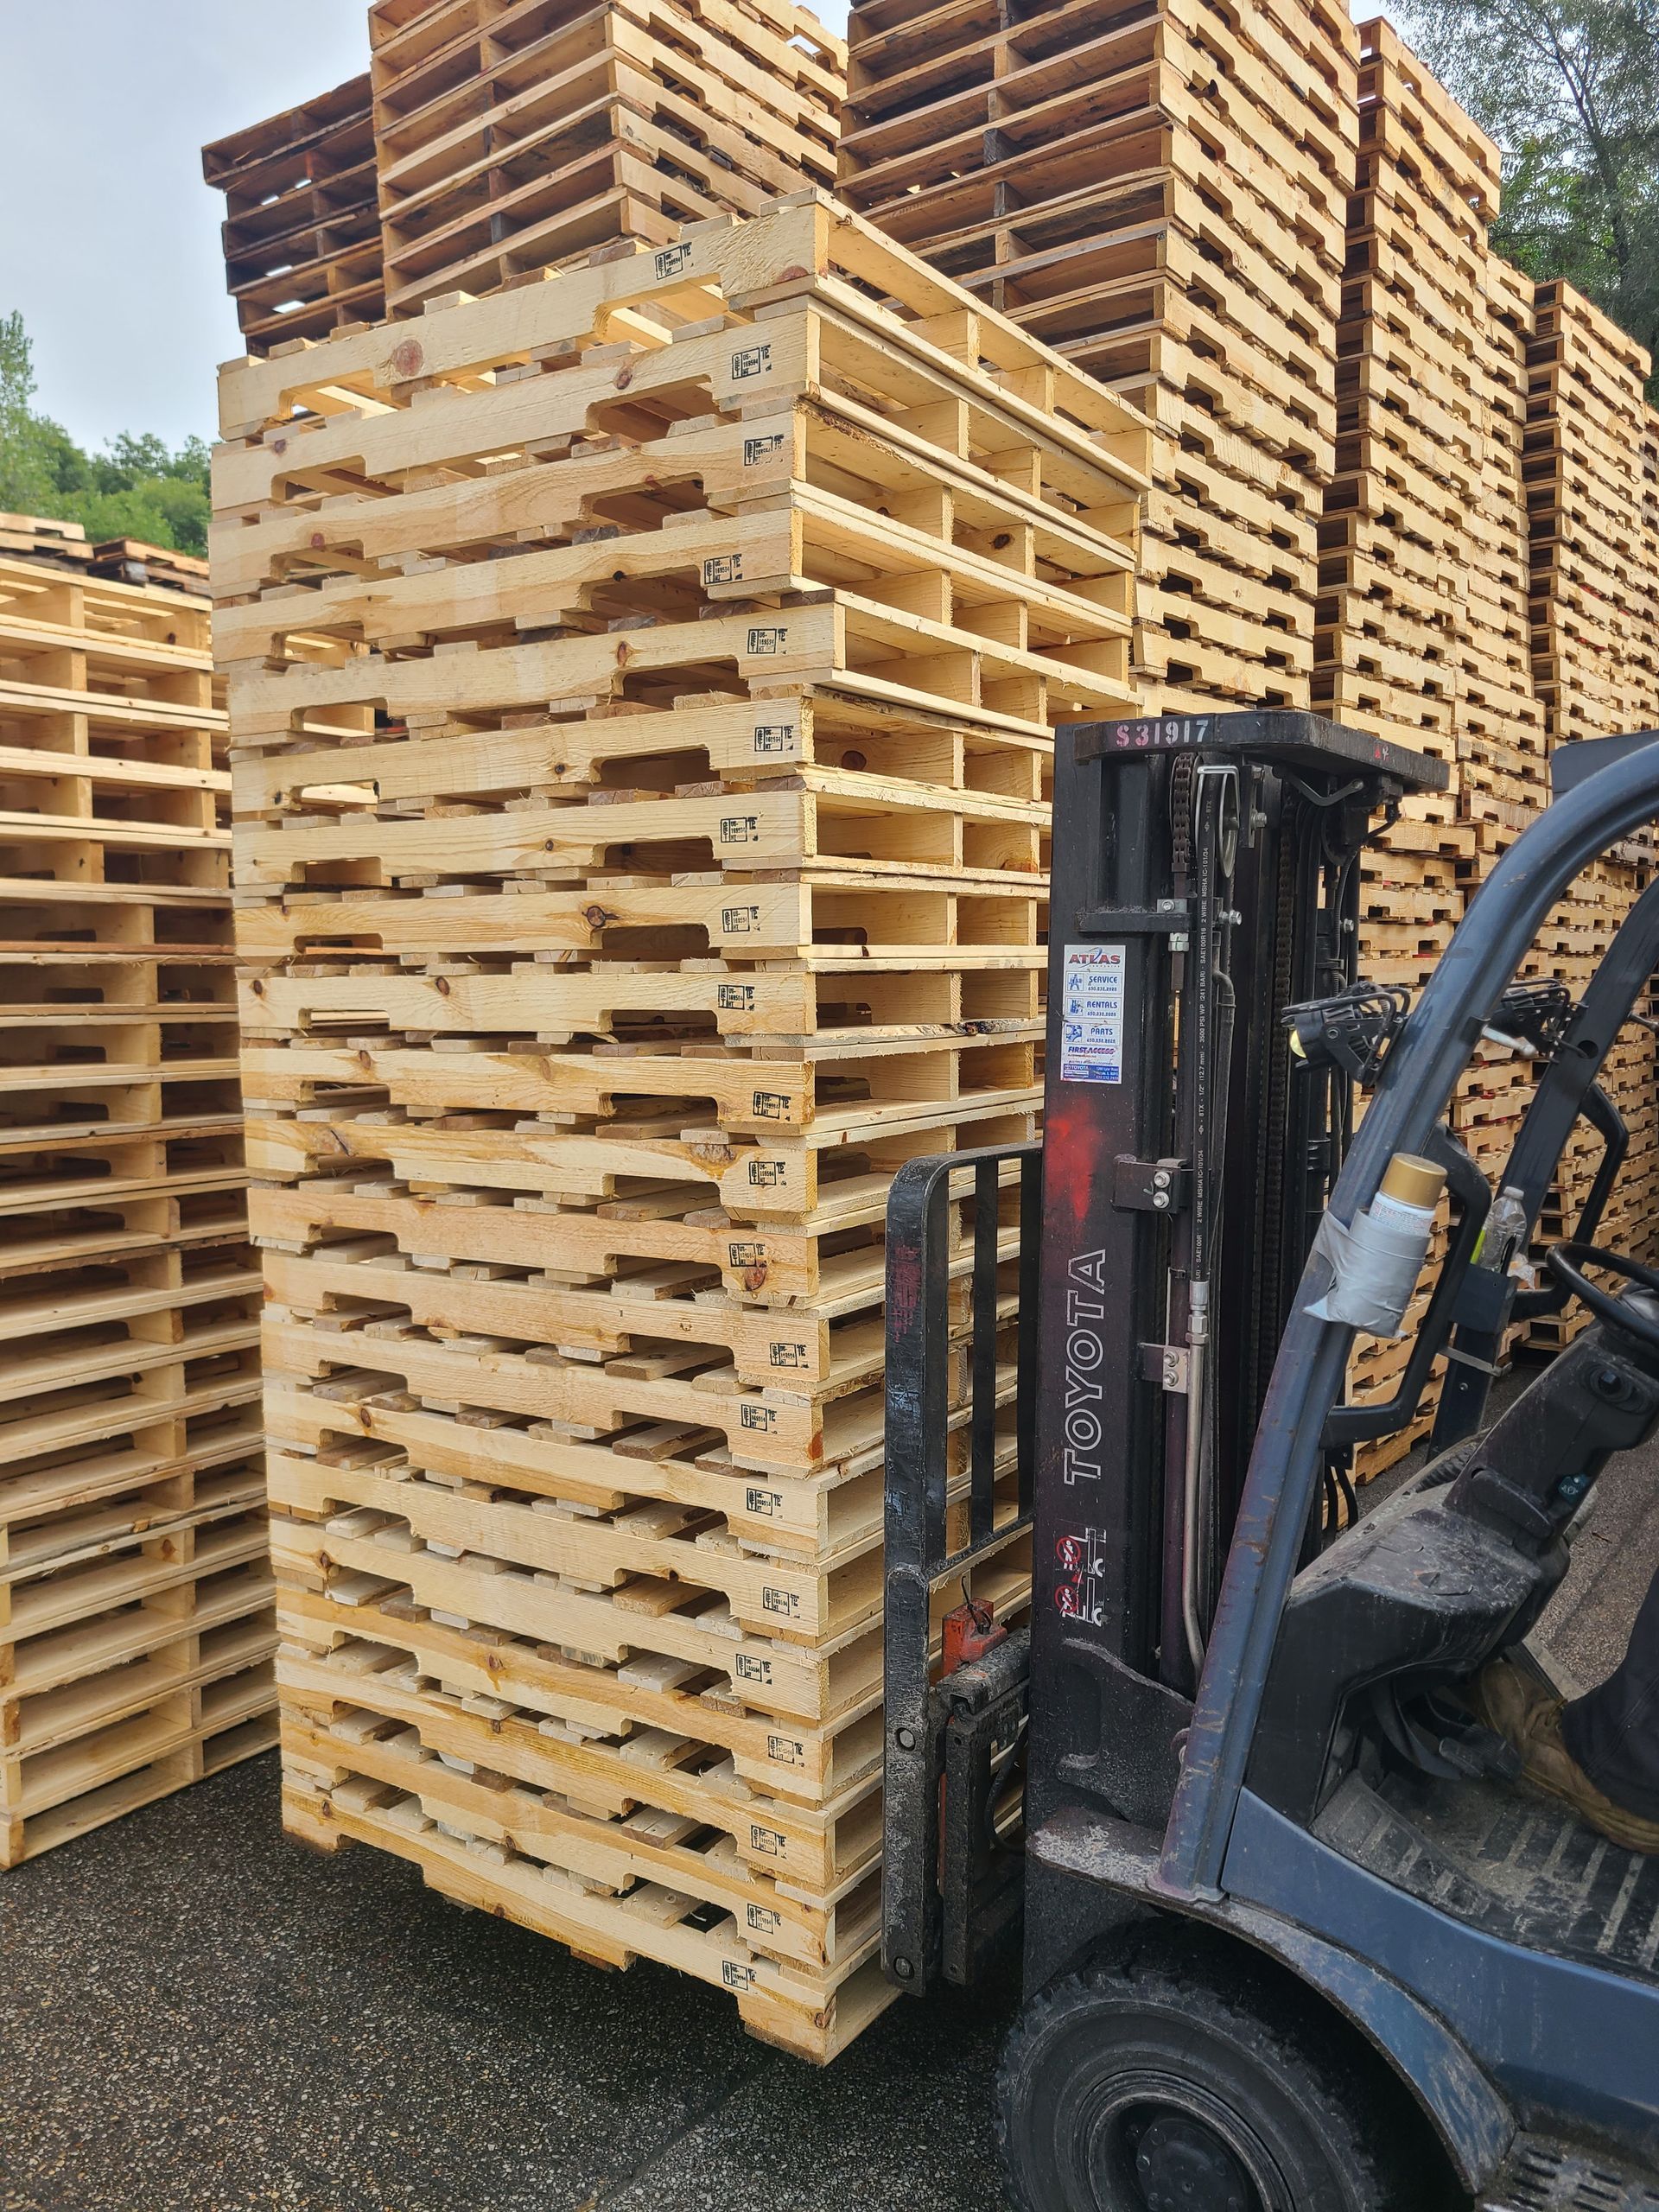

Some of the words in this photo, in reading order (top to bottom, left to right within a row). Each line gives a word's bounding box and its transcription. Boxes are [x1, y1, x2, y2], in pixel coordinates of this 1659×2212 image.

[1116, 720, 1208, 747] S31917
[1069, 954, 1120, 964] ATLAS
[1200, 1004, 1205, 1014] WP
[1064, 1249, 1105, 1485] TOYOTA
